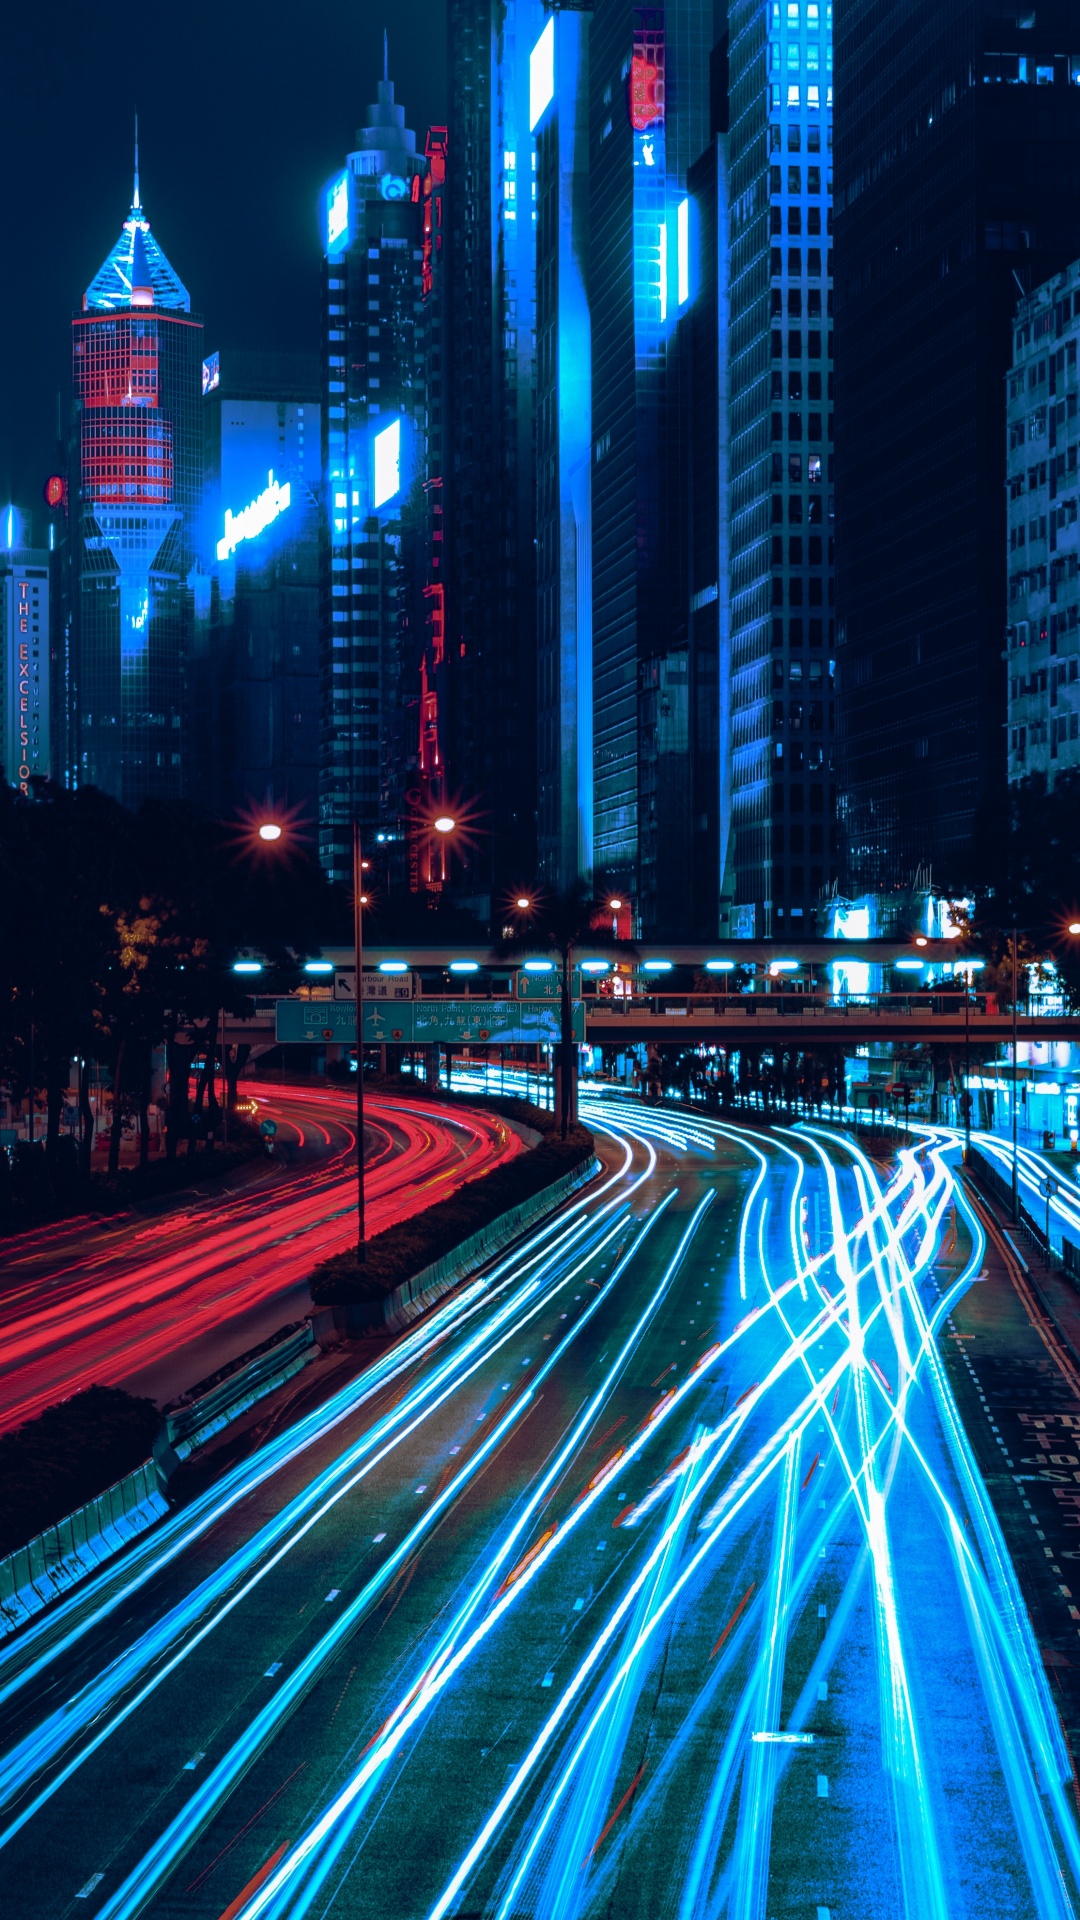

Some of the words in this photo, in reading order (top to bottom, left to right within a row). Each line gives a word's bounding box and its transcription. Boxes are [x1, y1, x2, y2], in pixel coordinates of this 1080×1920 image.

[18, 582, 30, 633] THE
[18, 643, 30, 796] EXCELSIOR
[388, 975, 409, 983] Road
[416, 1004, 438, 1013] North
[470, 1004, 503, 1013] Kowloon
[527, 1004, 553, 1014] Happy
